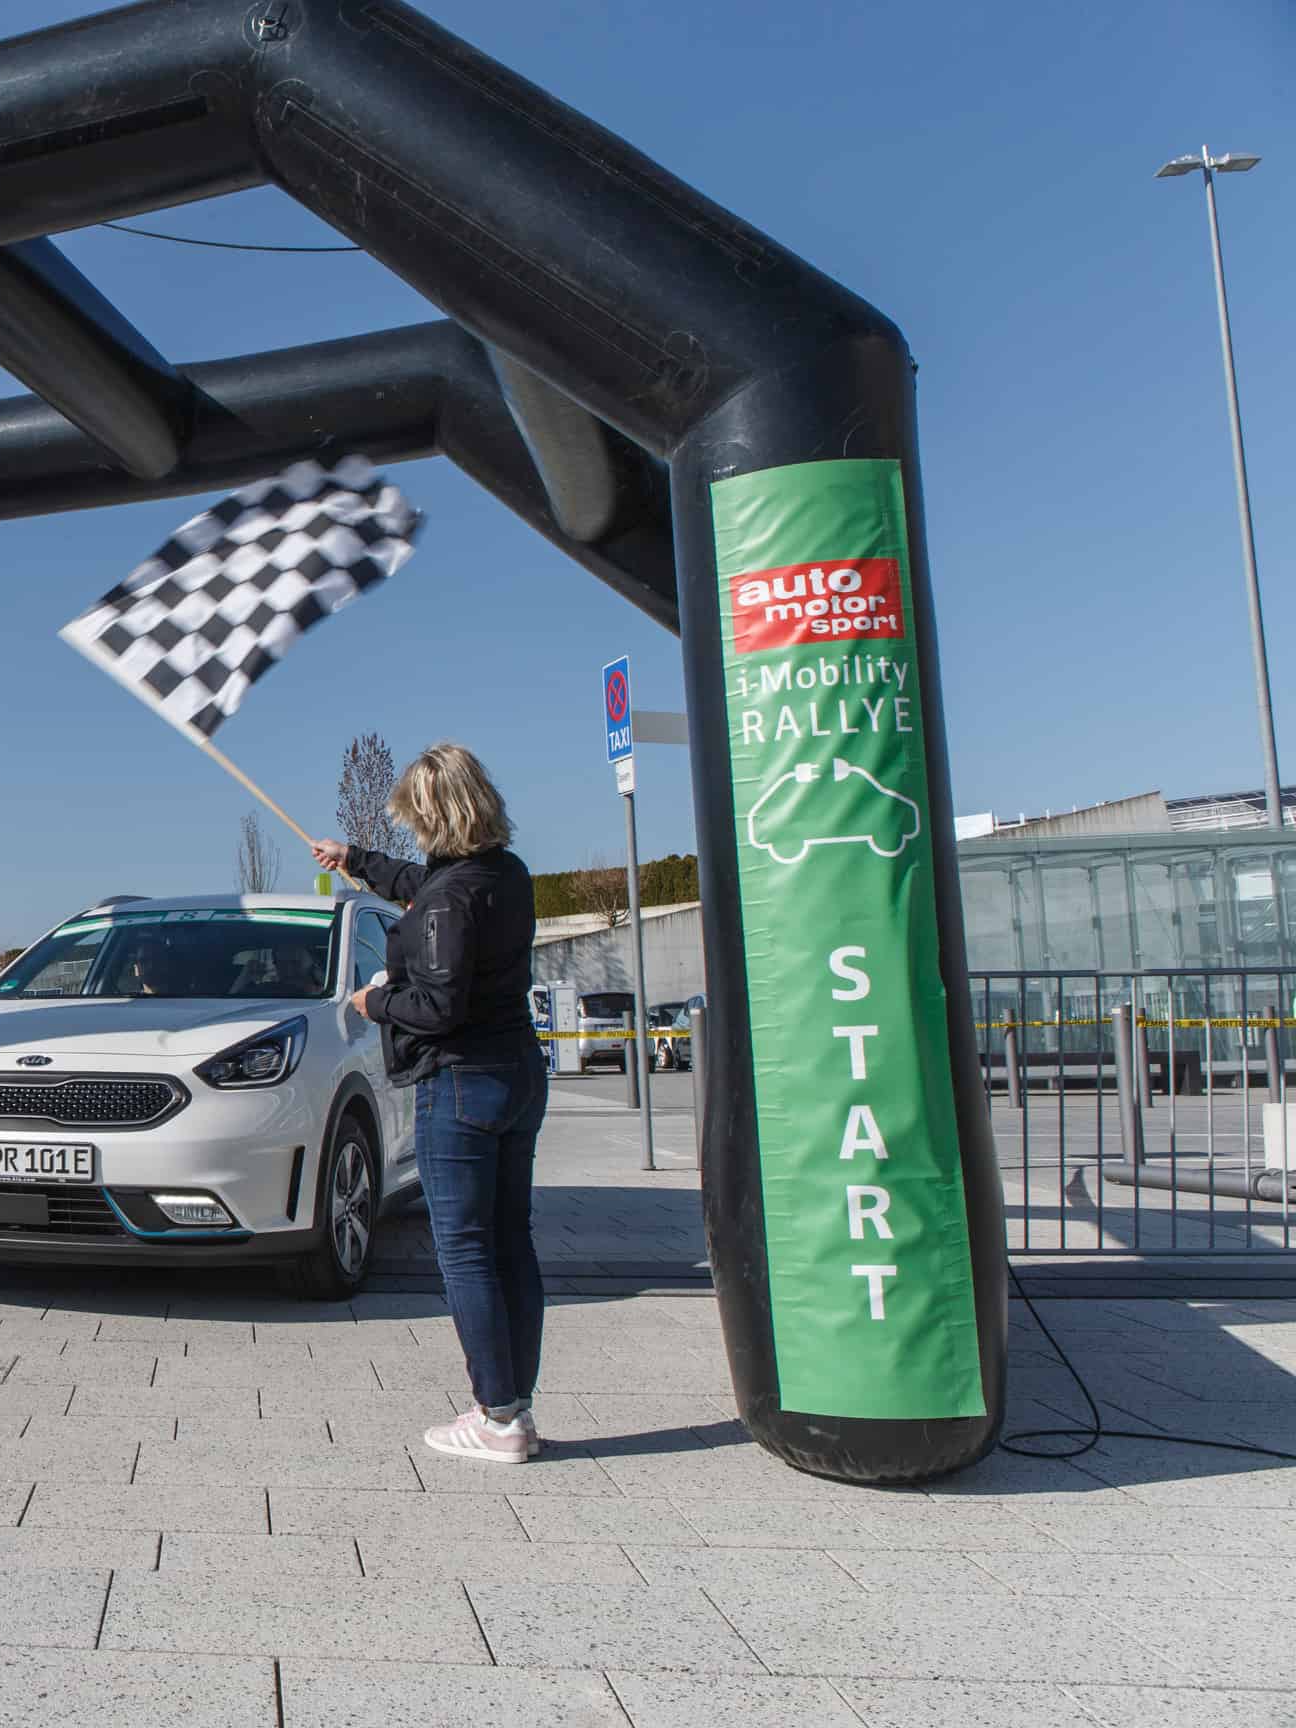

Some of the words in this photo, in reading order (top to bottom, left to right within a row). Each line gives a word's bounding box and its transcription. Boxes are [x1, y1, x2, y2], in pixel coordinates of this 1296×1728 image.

[737, 568, 862, 606] auto
[765, 595, 886, 622] motor
[810, 614, 898, 635] sport
[737, 654, 909, 698] i-Mobility
[741, 697, 913, 745] RALLYE
[609, 726, 631, 752] TAXI
[828, 945, 898, 1321] START
[25, 1148, 89, 1174] 101E
